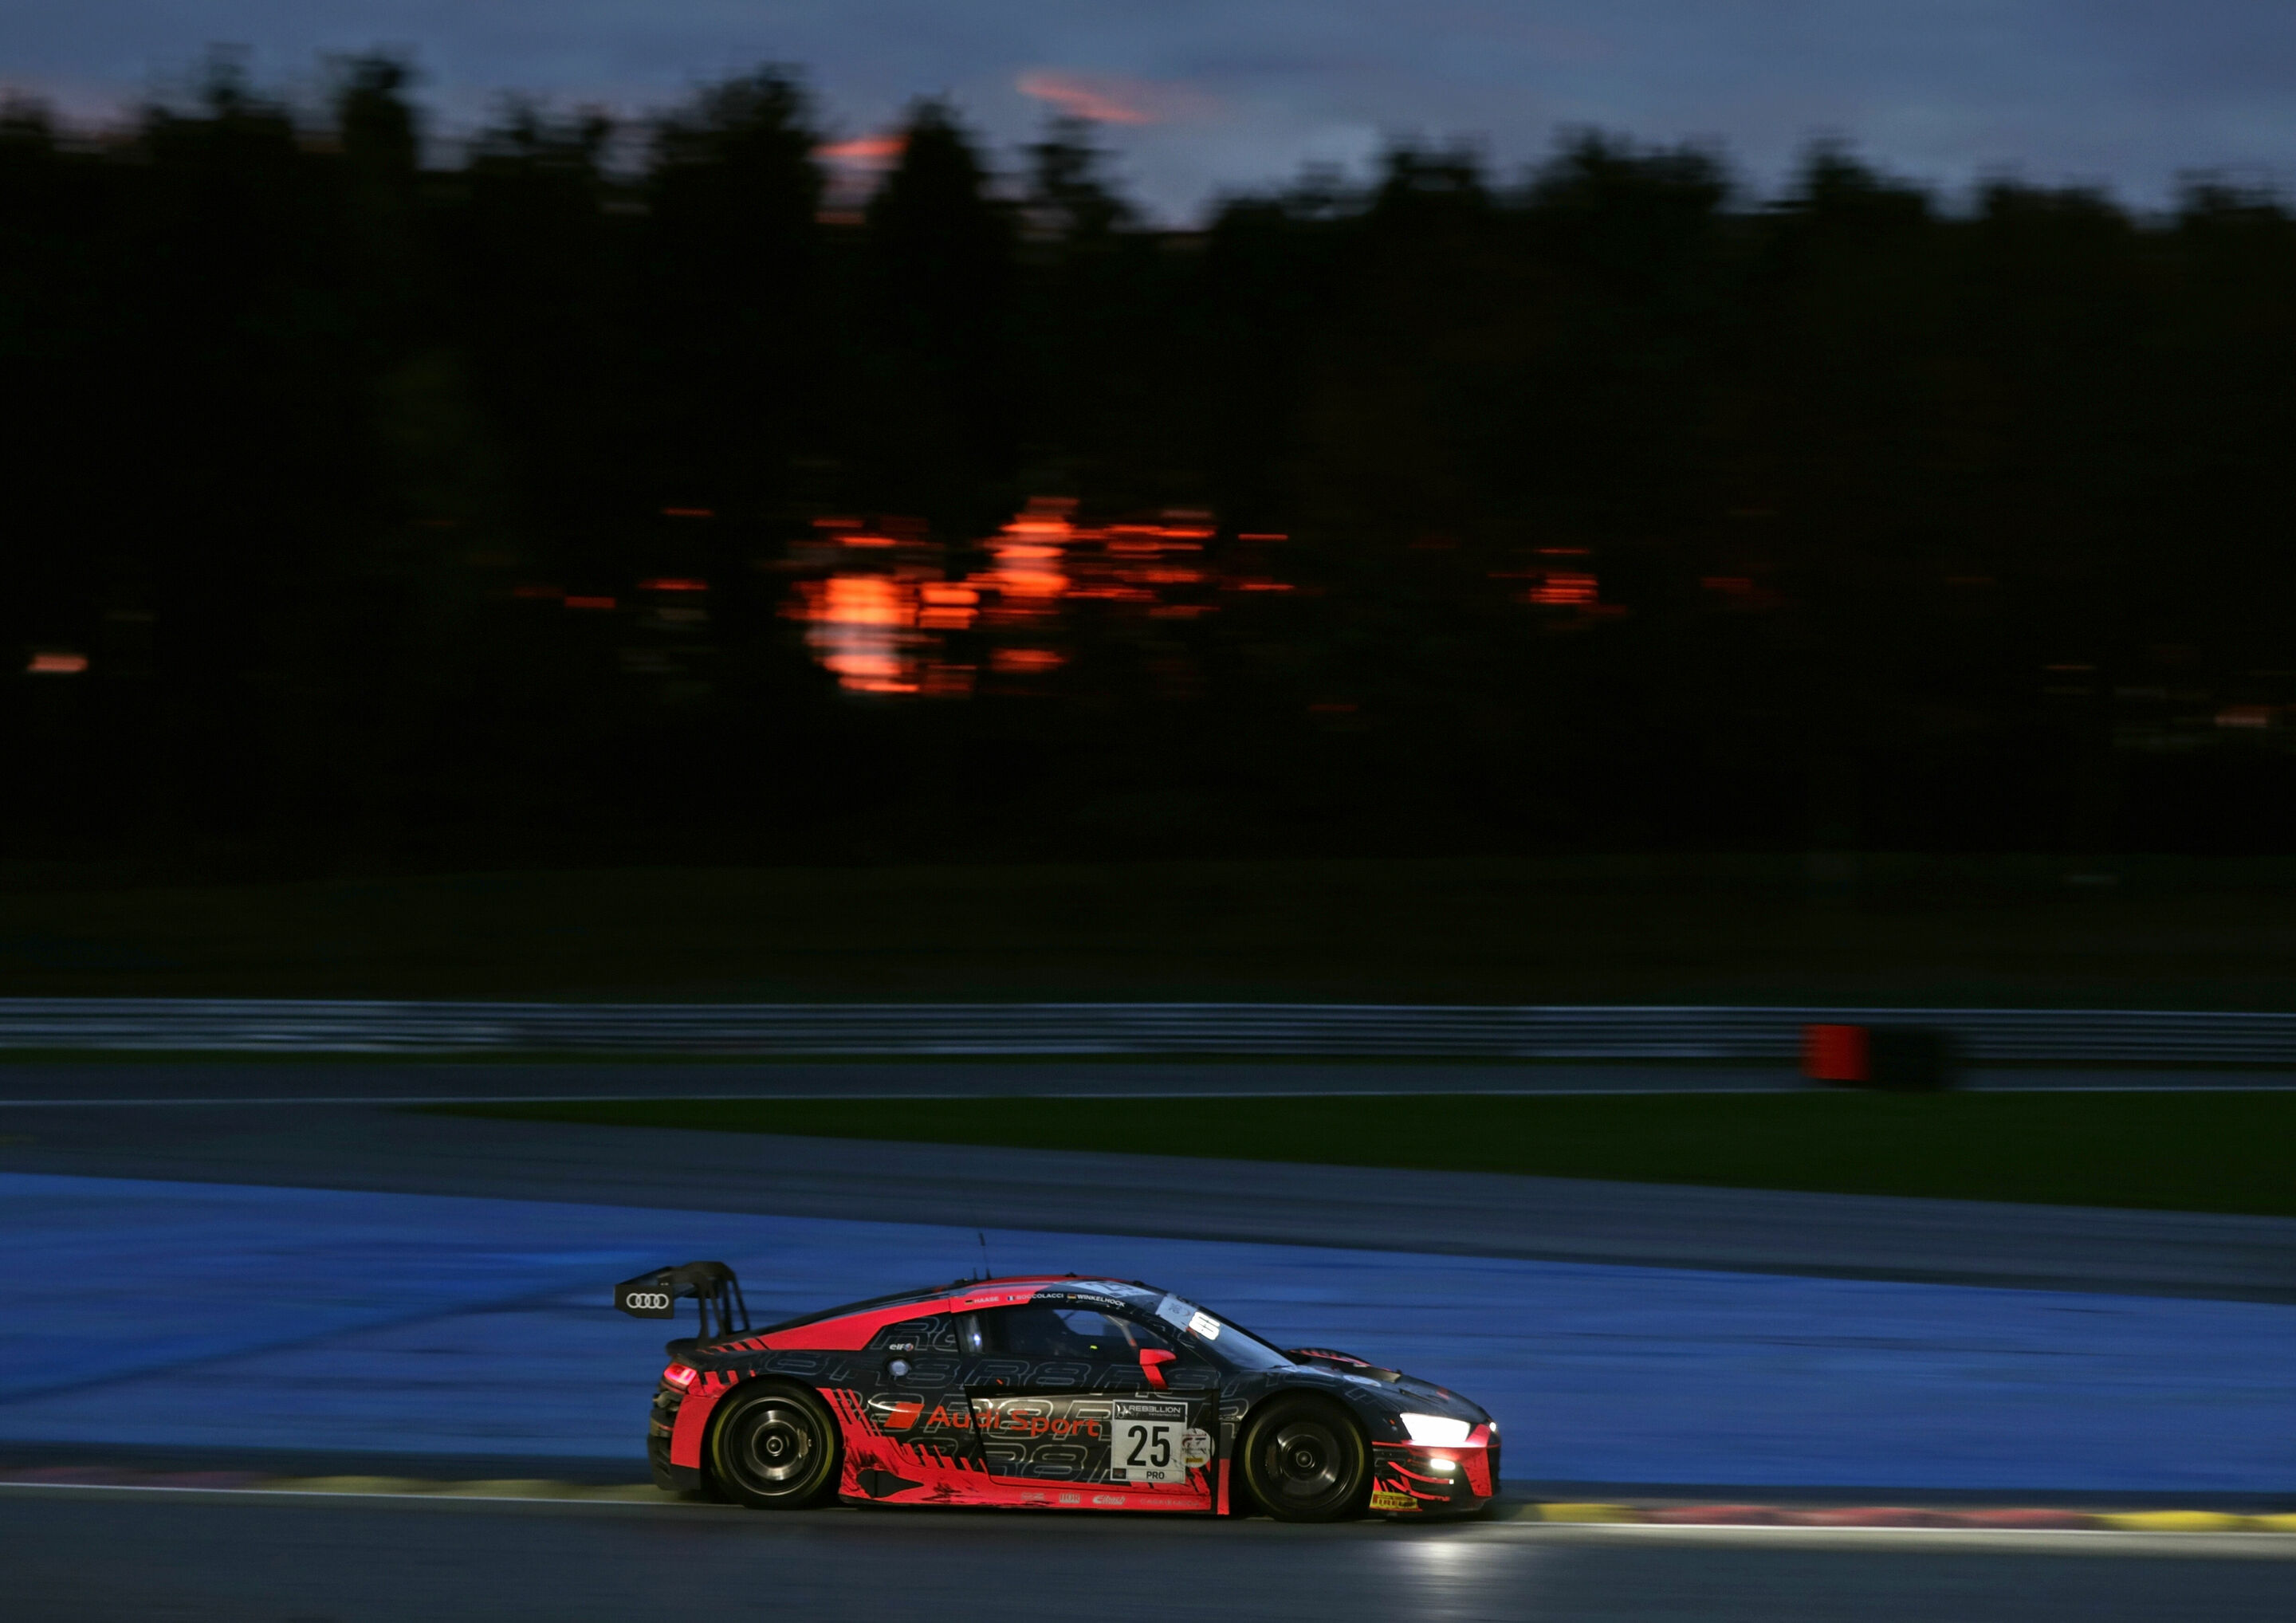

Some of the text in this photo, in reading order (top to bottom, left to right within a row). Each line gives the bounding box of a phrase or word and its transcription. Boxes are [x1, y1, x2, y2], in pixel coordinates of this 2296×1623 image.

[1077, 1294, 1126, 1307] WINKELHOCK
[926, 1405, 1100, 1437] Audi Sport
[1126, 1425, 1171, 1468] 25
[1146, 1471, 1166, 1480] PRO
